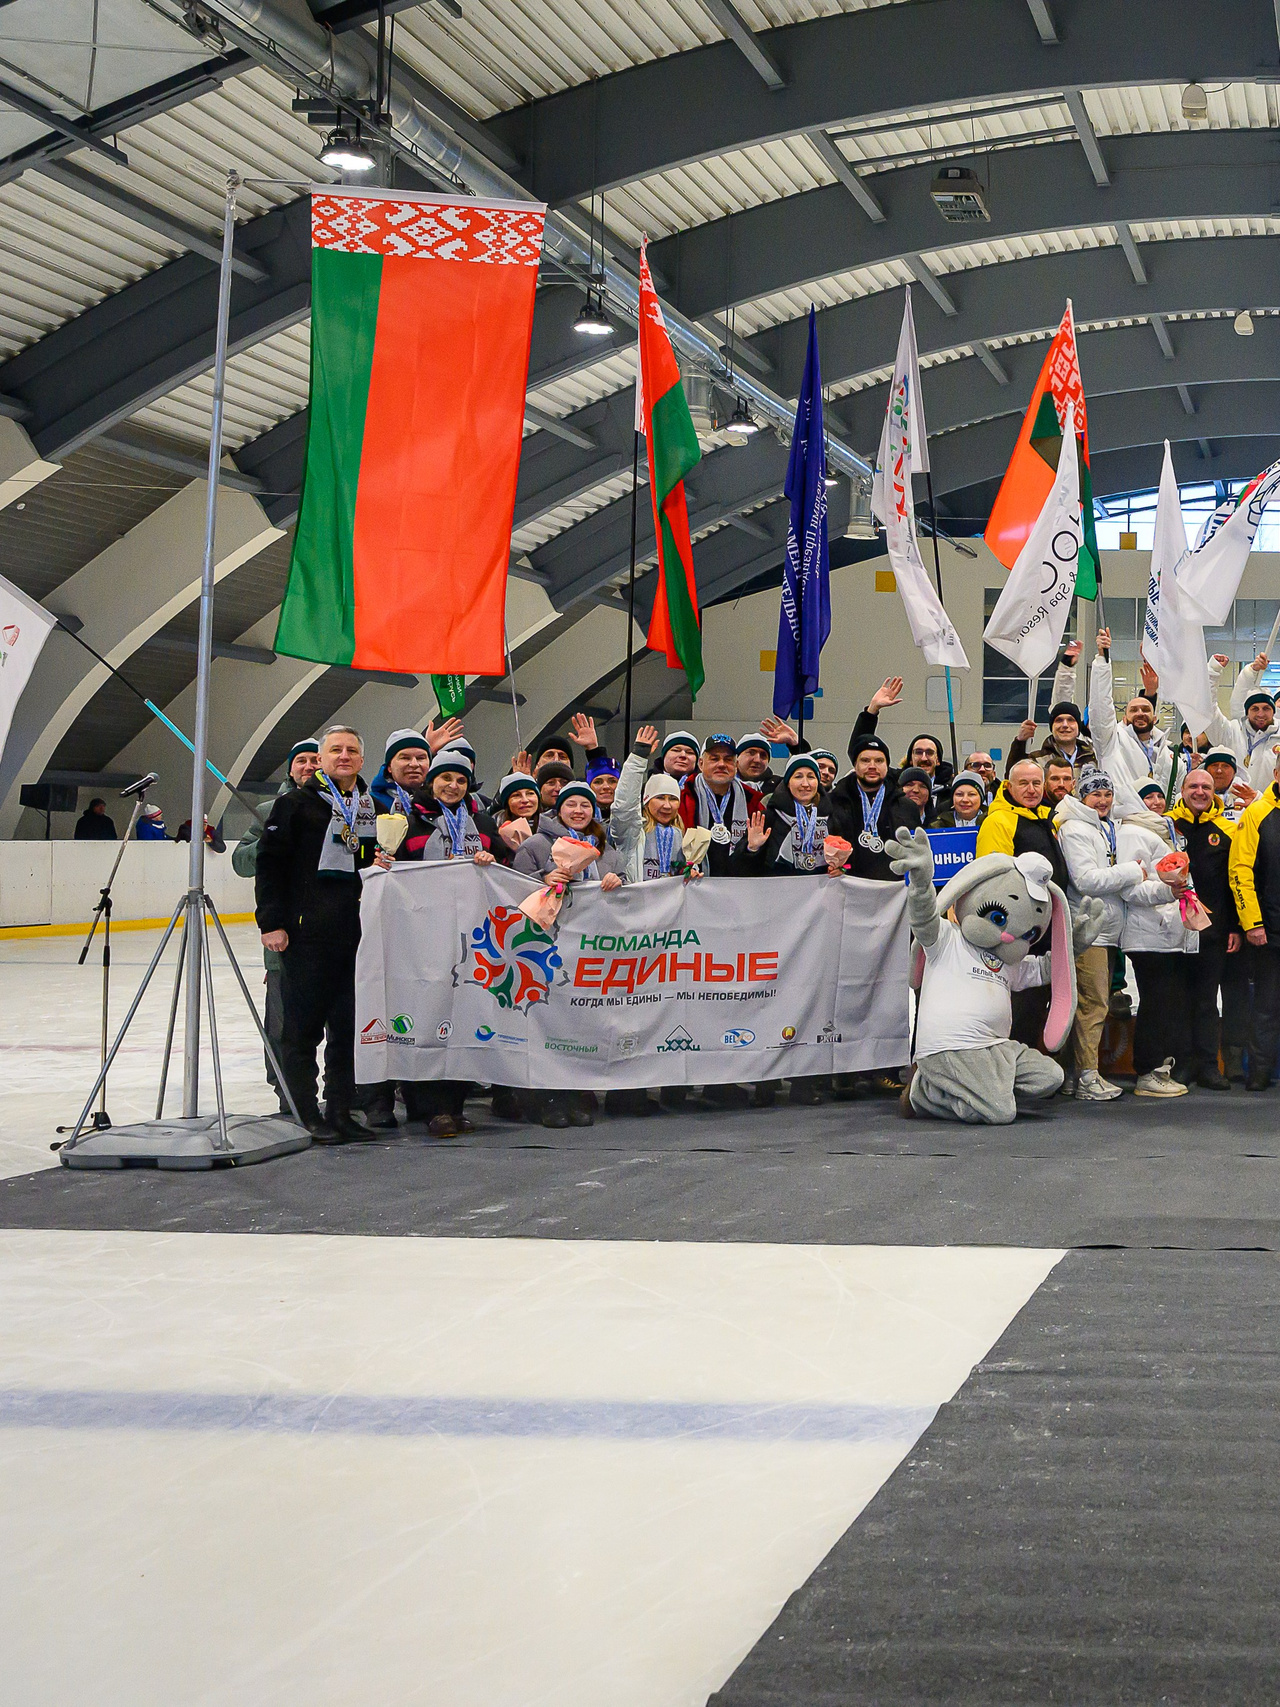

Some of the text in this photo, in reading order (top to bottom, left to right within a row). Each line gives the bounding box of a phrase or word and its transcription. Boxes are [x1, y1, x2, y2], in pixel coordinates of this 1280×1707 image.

[934, 851, 974, 865] иные
[579, 929, 701, 952] КОМАНДА
[573, 951, 779, 995] ЕДИНЫЕ
[570, 996, 604, 1009] КОГДА
[606, 995, 624, 1007] МЫ
[626, 993, 662, 1006] ЕДИНЫ
[676, 991, 696, 1001] МЫ
[698, 989, 778, 1002] НЕПОБЕДИМЫ!
[544, 1042, 598, 1053] ВОСТОЧНЫЙ
